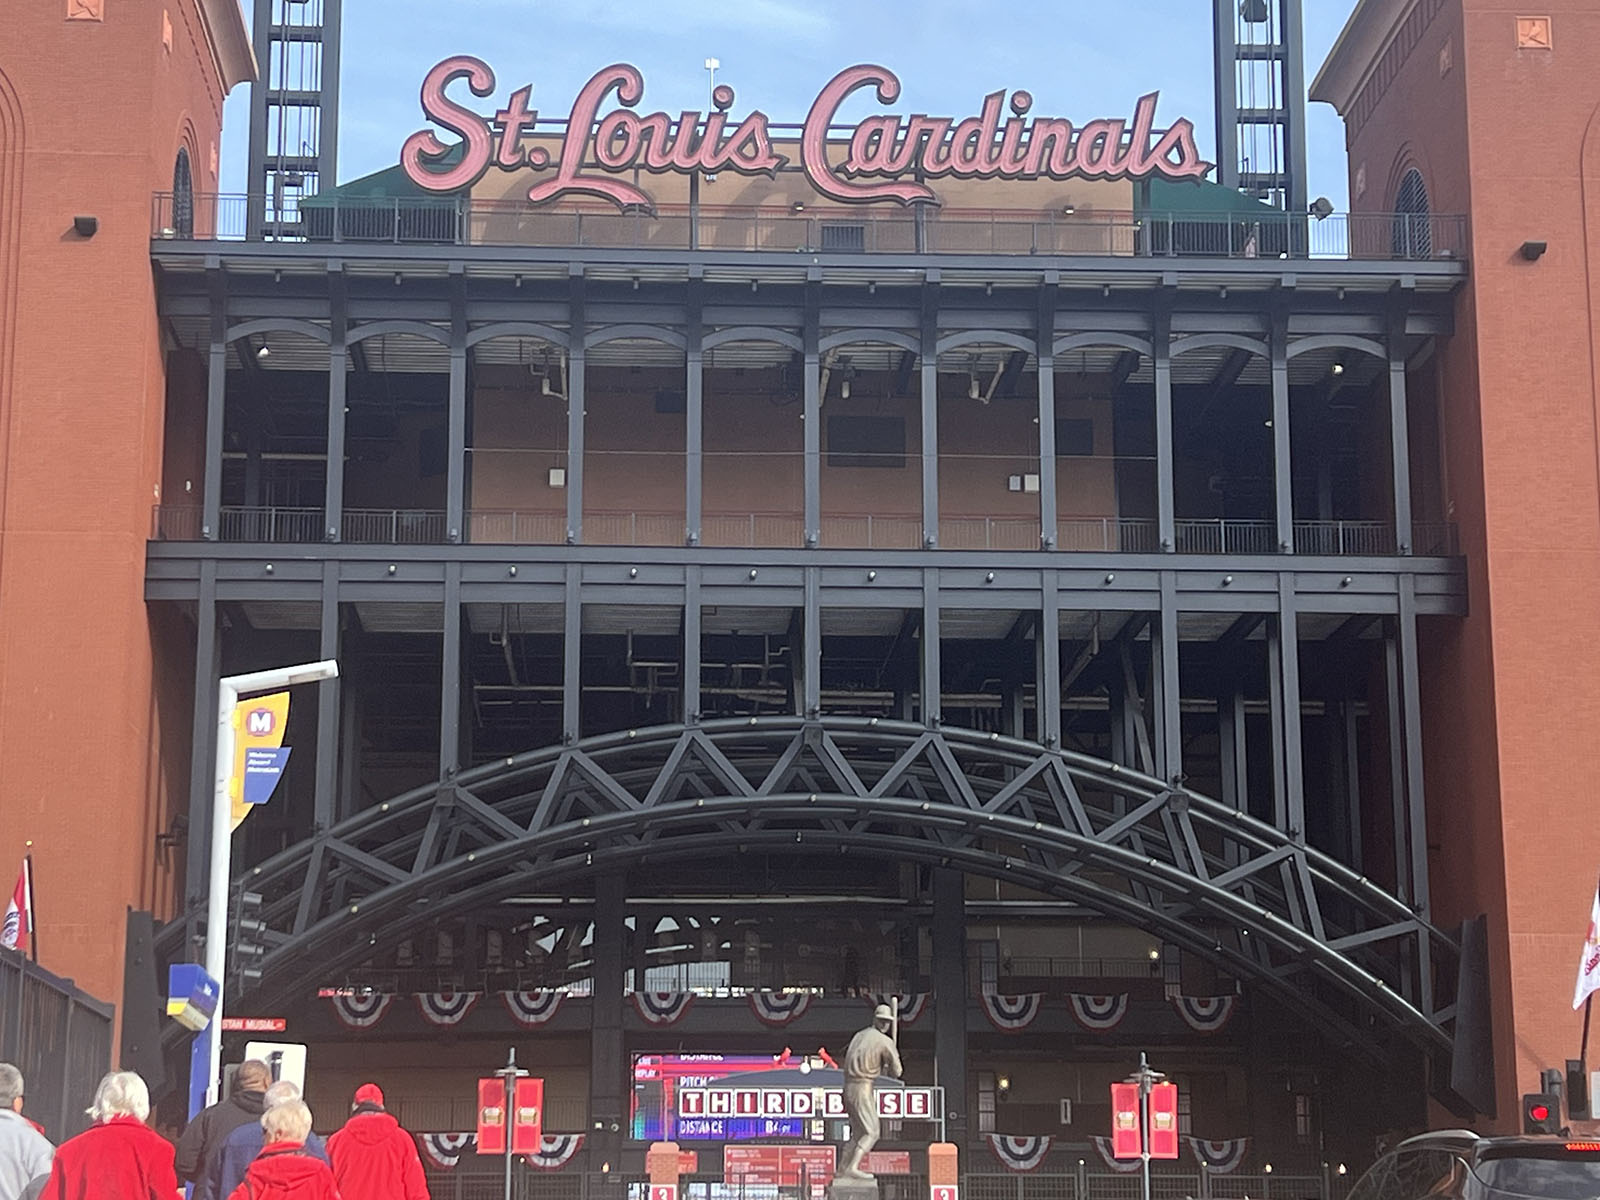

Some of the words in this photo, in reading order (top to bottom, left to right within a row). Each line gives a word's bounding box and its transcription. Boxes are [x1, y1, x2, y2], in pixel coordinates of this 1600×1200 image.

[400, 55, 549, 194] St.
[527, 63, 788, 216] Louis
[801, 63, 1216, 209] Cardinals
[250, 711, 272, 733] M
[686, 1092, 812, 1114] THIRD
[827, 1092, 924, 1114] BSE
[680, 1121, 723, 1135] DISTANCE
